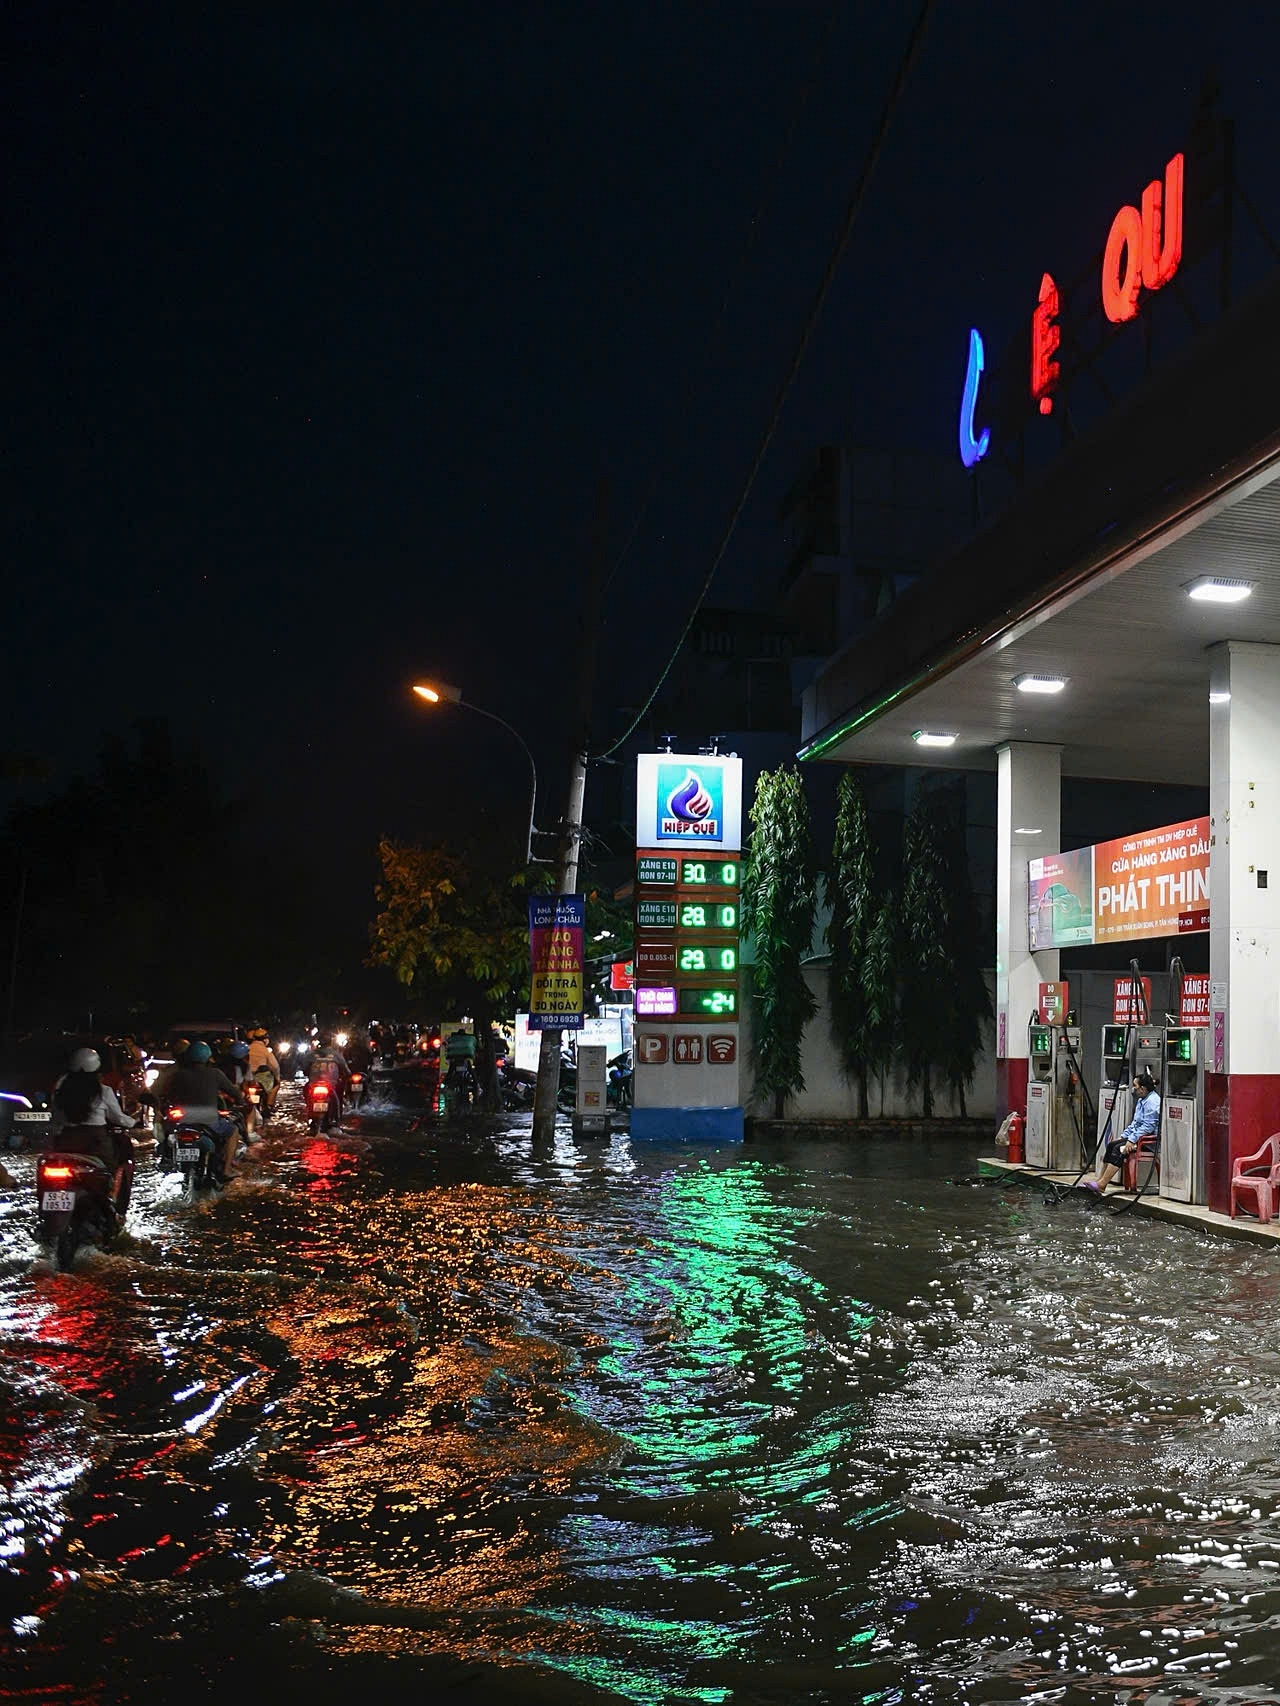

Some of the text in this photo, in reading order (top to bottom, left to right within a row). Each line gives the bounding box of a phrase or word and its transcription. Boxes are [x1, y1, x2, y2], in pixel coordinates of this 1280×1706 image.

[640, 860, 675, 870] XĂNG E10
[1112, 857, 1129, 873] CỬA
[1131, 852, 1157, 869] HÀNG
[1160, 846, 1186, 863] XĂNG
[640, 872, 675, 880] RON 97-III
[1098, 874, 1150, 916] PHÁT
[640, 904, 675, 913] XĂNG E10
[557, 914, 580, 923] CHÂU
[640, 915, 655, 923] RON
[1183, 978, 1201, 994] XĂNG
[535, 999, 578, 1010] 30 NGÀY
[1182, 999, 1196, 1012] RON
[646, 1038, 661, 1058] P
